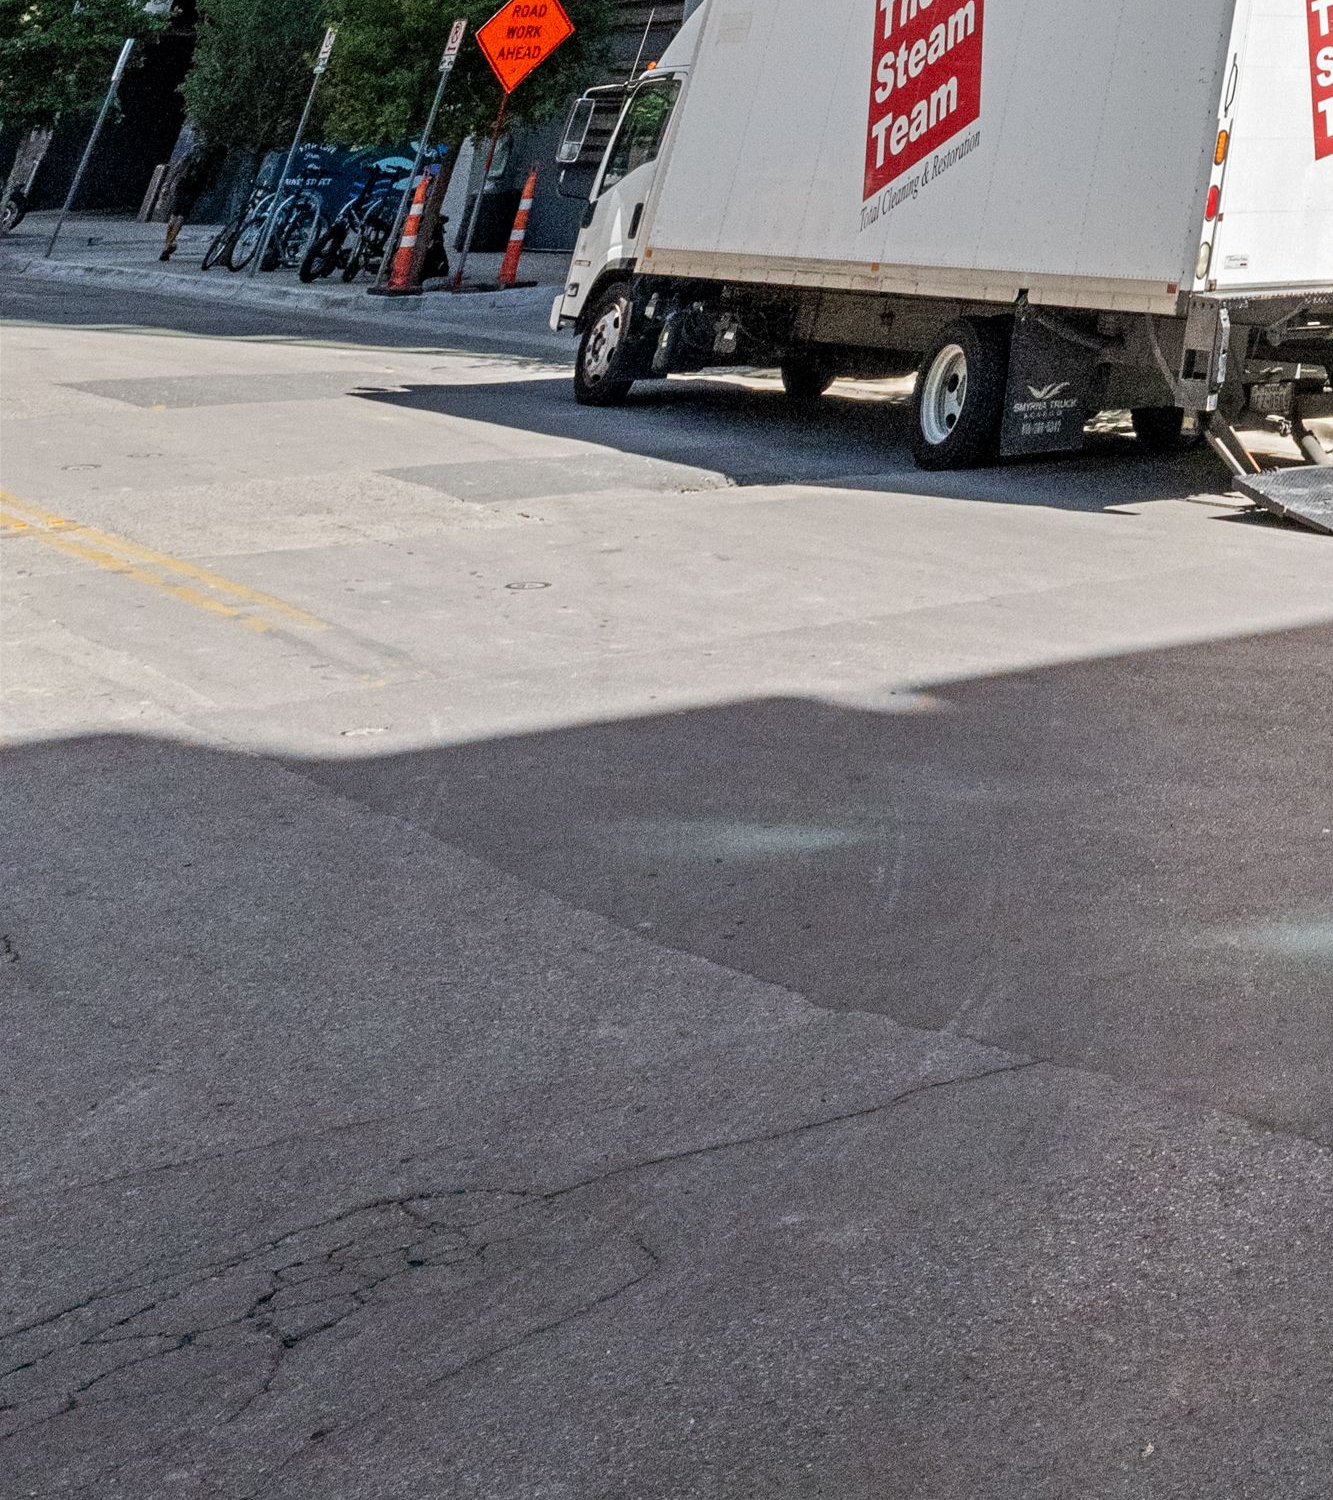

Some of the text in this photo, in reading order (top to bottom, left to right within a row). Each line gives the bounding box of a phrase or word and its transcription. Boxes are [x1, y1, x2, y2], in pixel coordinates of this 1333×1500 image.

[506, 25, 542, 40] WORK
[512, 4, 548, 18] ROAD
[496, 46, 542, 60] AHEAD
[874, 0, 976, 104] Steam
[871, 75, 958, 170] Team
[860, 130, 980, 232] Total Cleaning & Restoration
